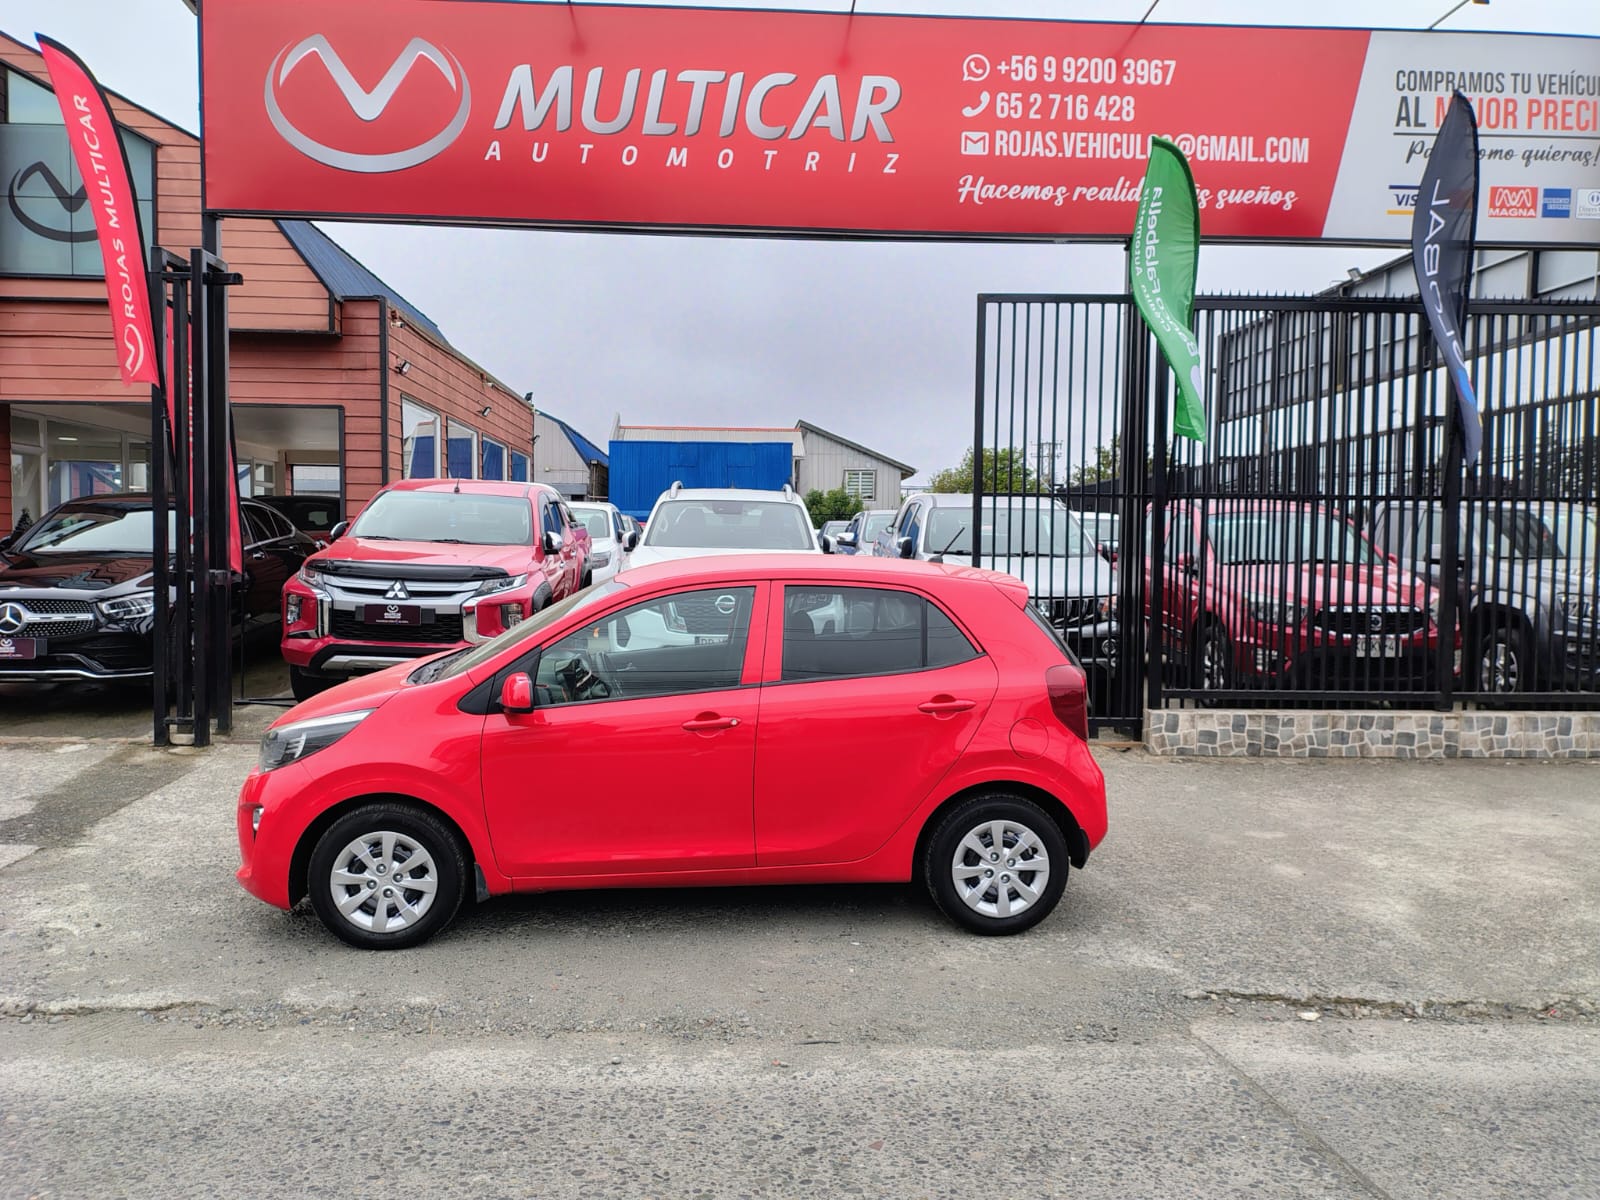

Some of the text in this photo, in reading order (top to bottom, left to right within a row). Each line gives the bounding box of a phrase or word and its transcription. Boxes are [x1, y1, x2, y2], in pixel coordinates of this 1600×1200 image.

[997, 55, 1177, 85] +56 9 9200 3967
[1395, 69, 1600, 96] COMPRAMOS TU VEHÍCU
[493, 63, 902, 143] MULTICAR
[995, 92, 1136, 122] 65 2 716 428
[1394, 96, 1427, 128] AL
[1434, 96, 1518, 130] MJOR
[484, 141, 900, 174] AUTOMOTRIZ
[994, 129, 1310, 164] ROJAS.VEHICUL@GMAIL.COM
[1521, 144, 1600, 168] quieras!
[73, 95, 136, 319] ROJAS MULTICAR
[957, 174, 1070, 207] Hacemos
[1215, 186, 1299, 211] sueños
[1394, 193, 1419, 207] VIS
[1488, 207, 1536, 217] MAGNA
